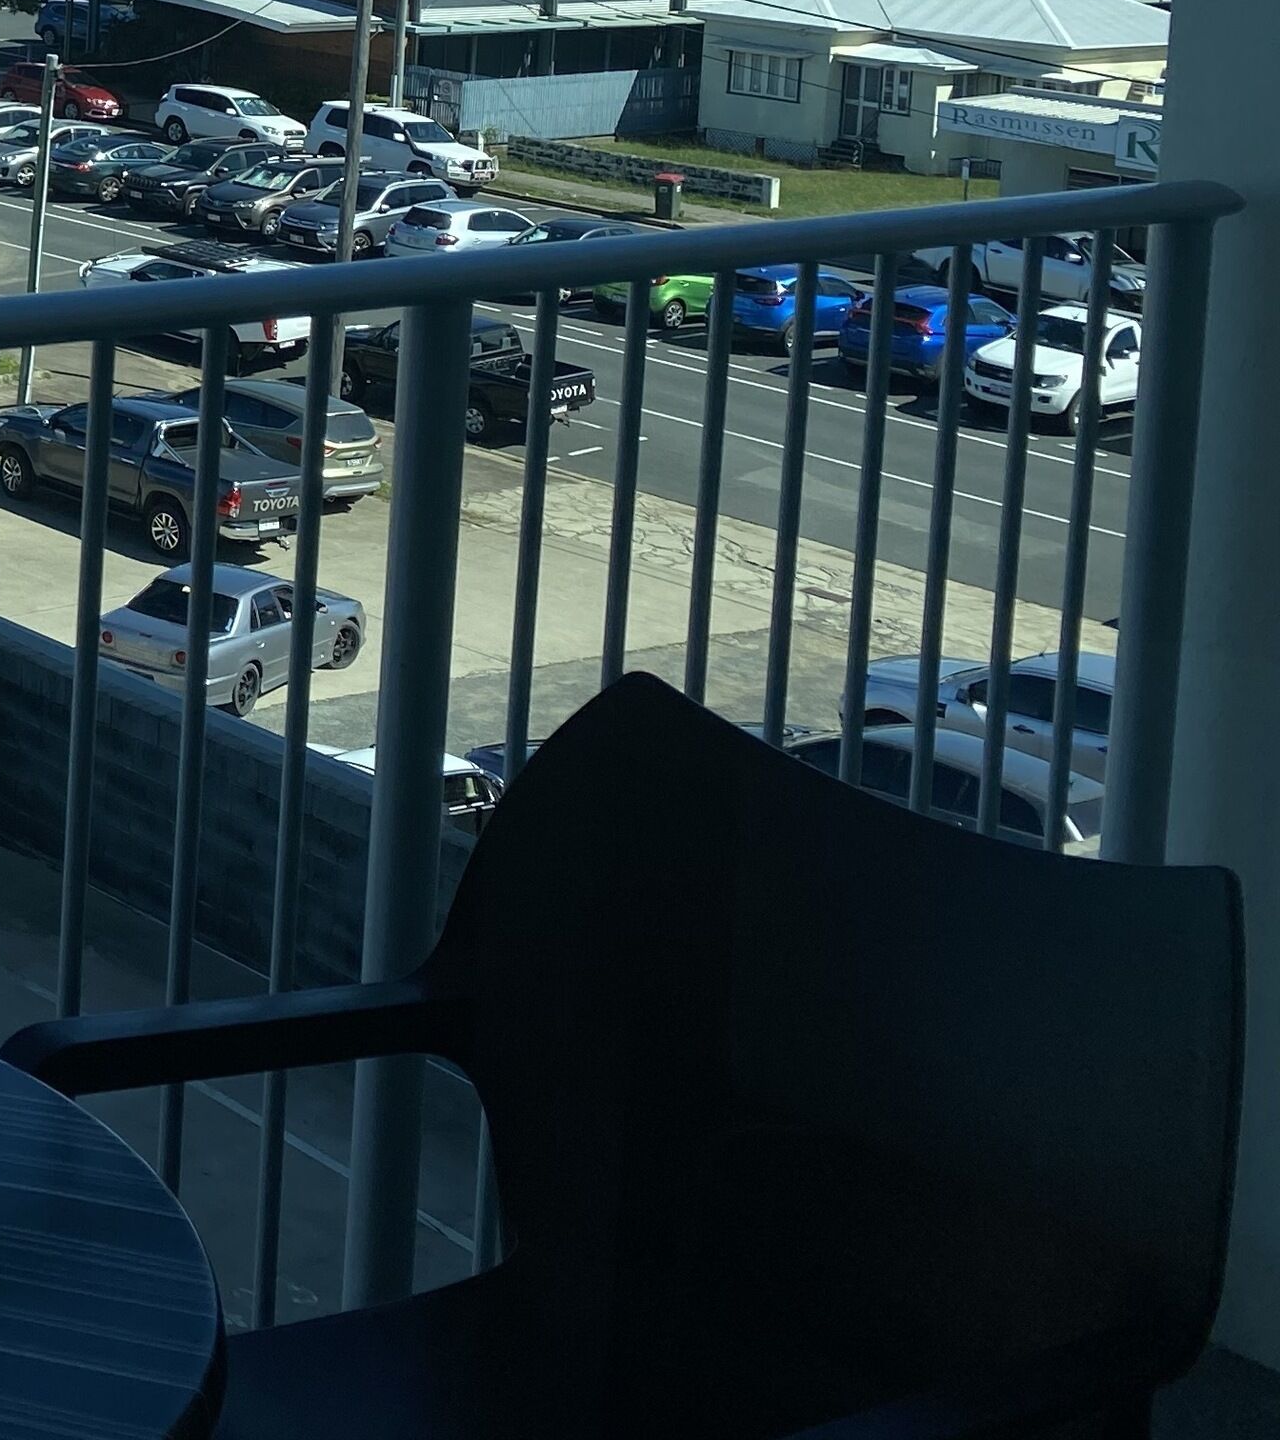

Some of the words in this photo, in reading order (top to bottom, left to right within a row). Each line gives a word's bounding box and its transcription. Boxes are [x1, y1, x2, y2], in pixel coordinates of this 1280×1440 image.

[953, 107, 1096, 142] Rasmussen
[551, 384, 586, 401] OYOTA
[253, 495, 300, 512] TOYOTA
